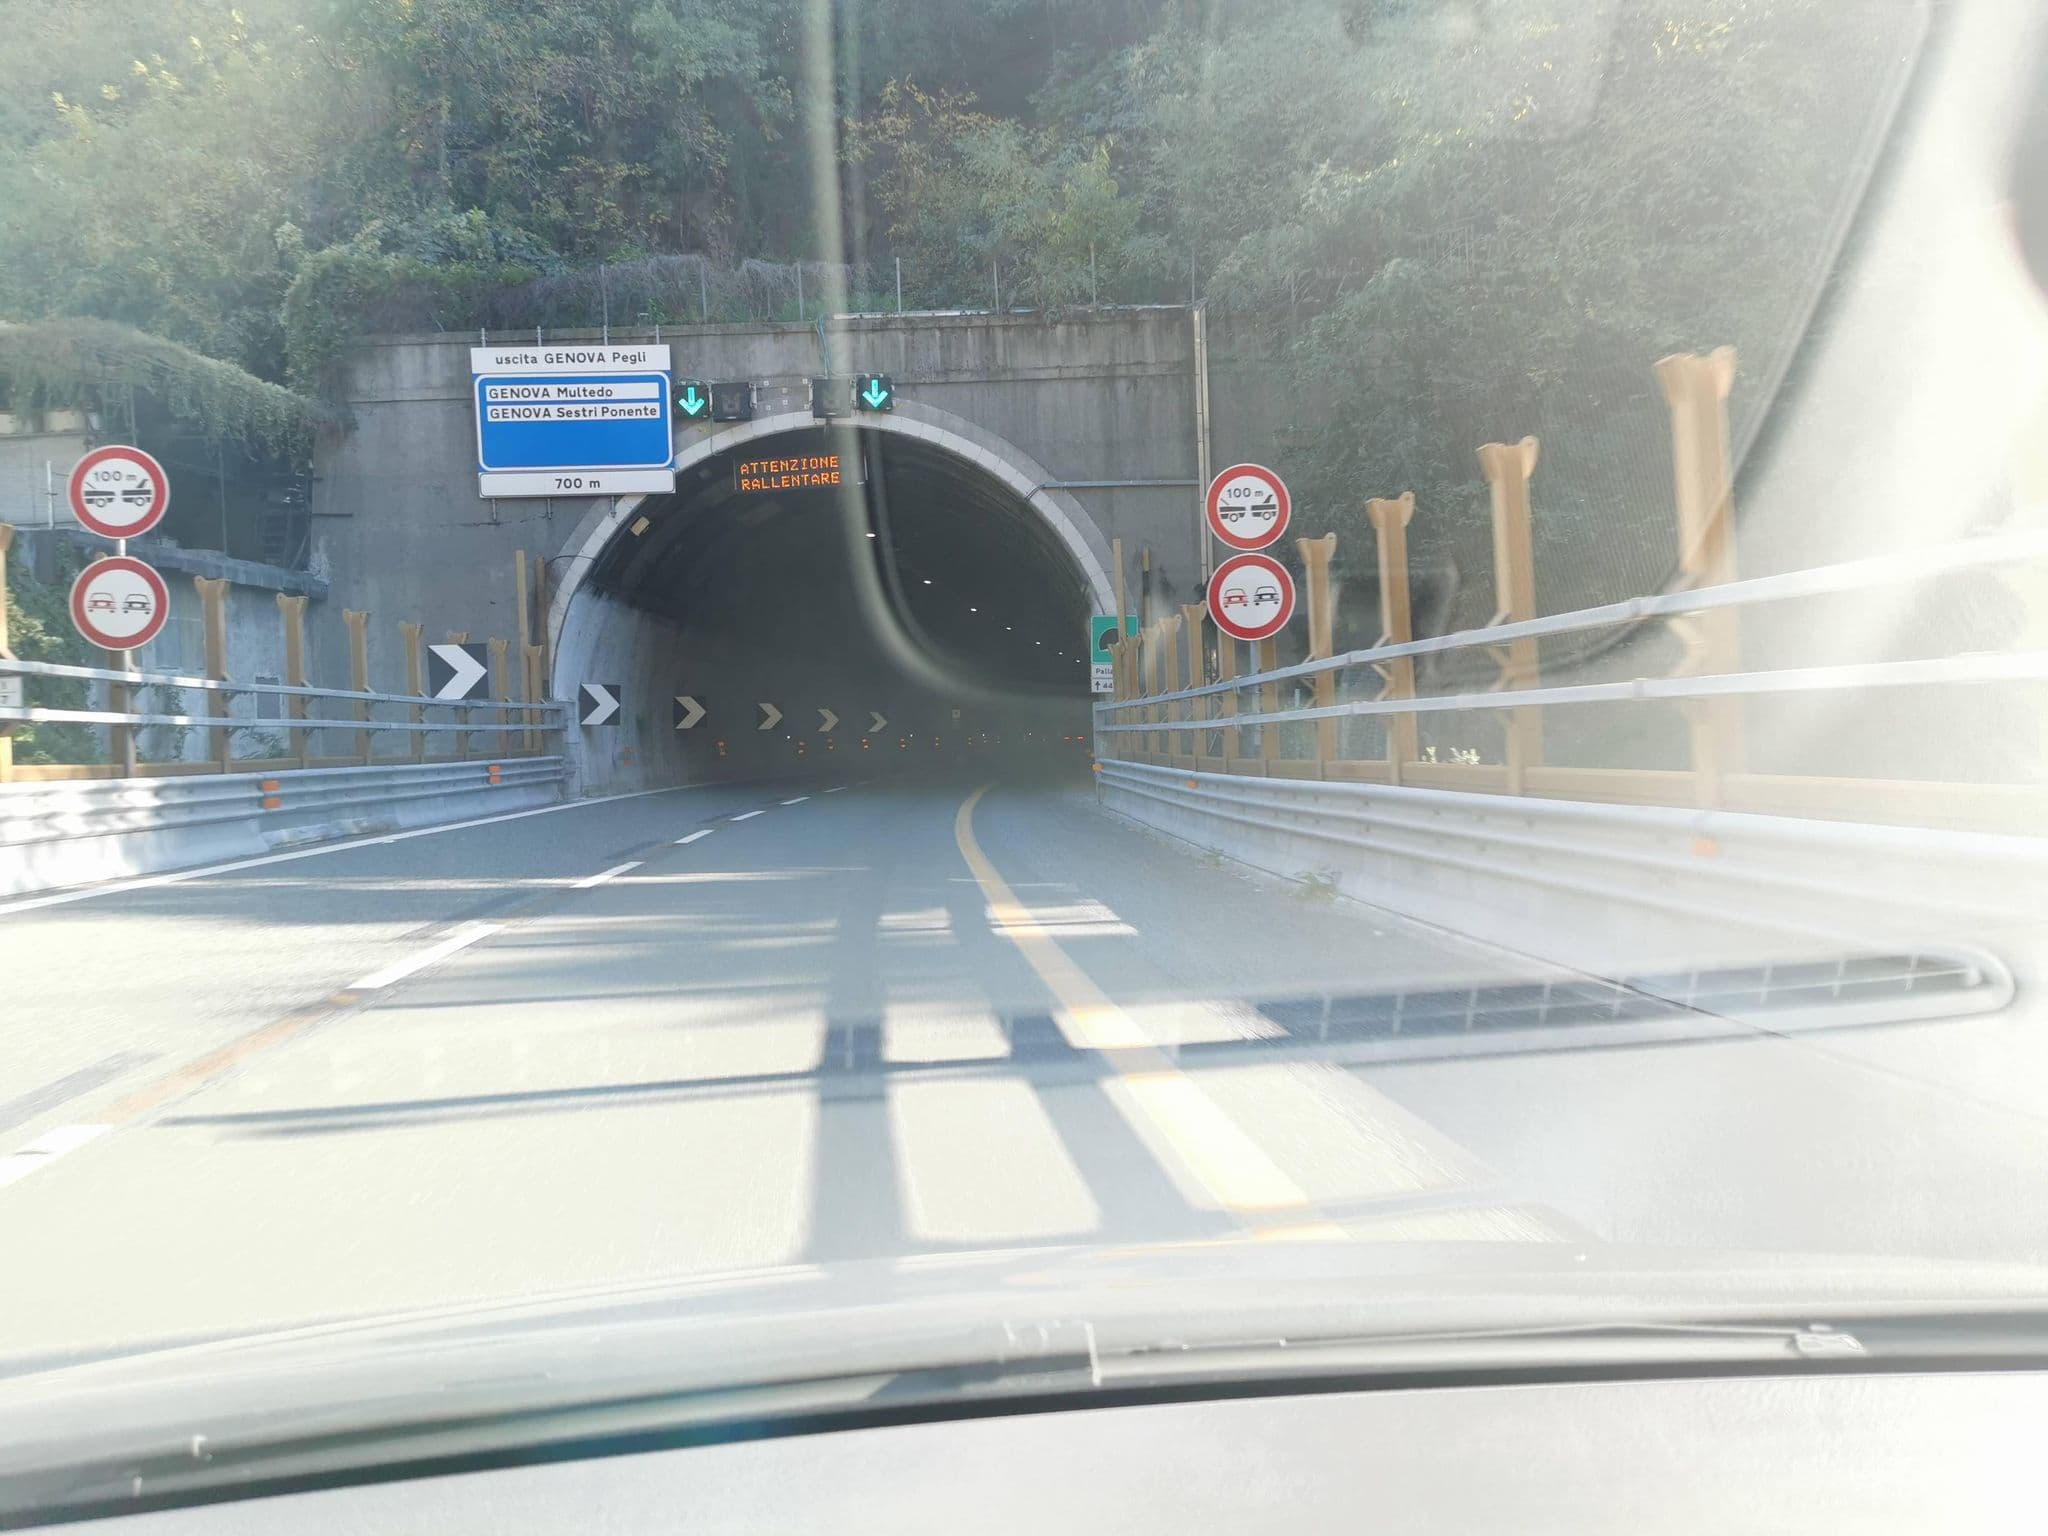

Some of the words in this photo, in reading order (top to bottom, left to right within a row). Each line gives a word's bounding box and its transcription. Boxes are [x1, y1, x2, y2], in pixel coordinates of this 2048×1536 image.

[496, 353, 538, 365] uscita
[544, 352, 606, 364] GENOVA
[612, 351, 647, 365] Pegli
[489, 387, 551, 399] GENOVA
[557, 385, 614, 398] Multedo
[490, 407, 552, 419] GENOVA
[557, 406, 598, 418] Sestri
[602, 404, 657, 417] Ponente
[740, 456, 839, 475] ATTENZIONE
[94, 471, 121, 482] 100
[555, 478, 583, 489] 700
[589, 480, 601, 489] m
[741, 472, 841, 491] RALLENTARE
[1227, 487, 1251, 499] 100
